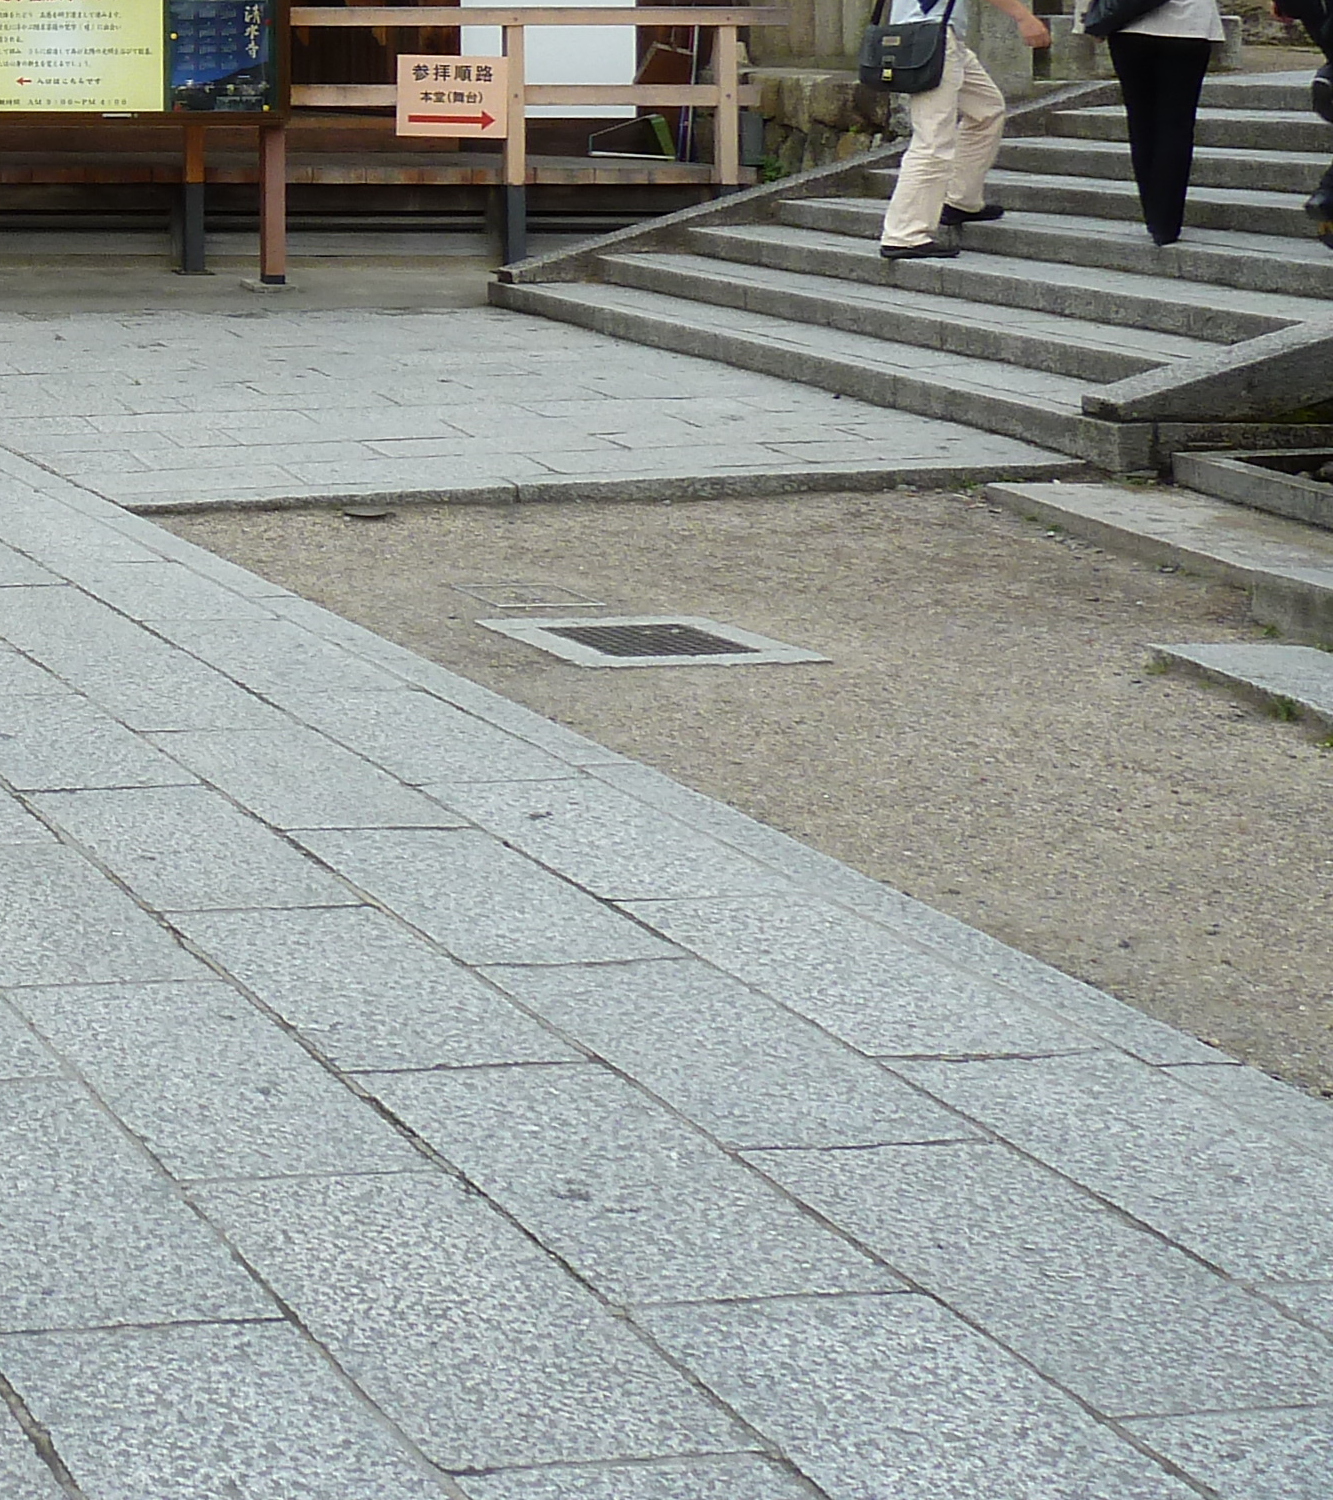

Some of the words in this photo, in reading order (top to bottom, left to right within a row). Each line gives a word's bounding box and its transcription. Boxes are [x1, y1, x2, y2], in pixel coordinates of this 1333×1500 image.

[243, 3, 261, 59] 清水寺
[412, 63, 493, 82] 参拝順路
